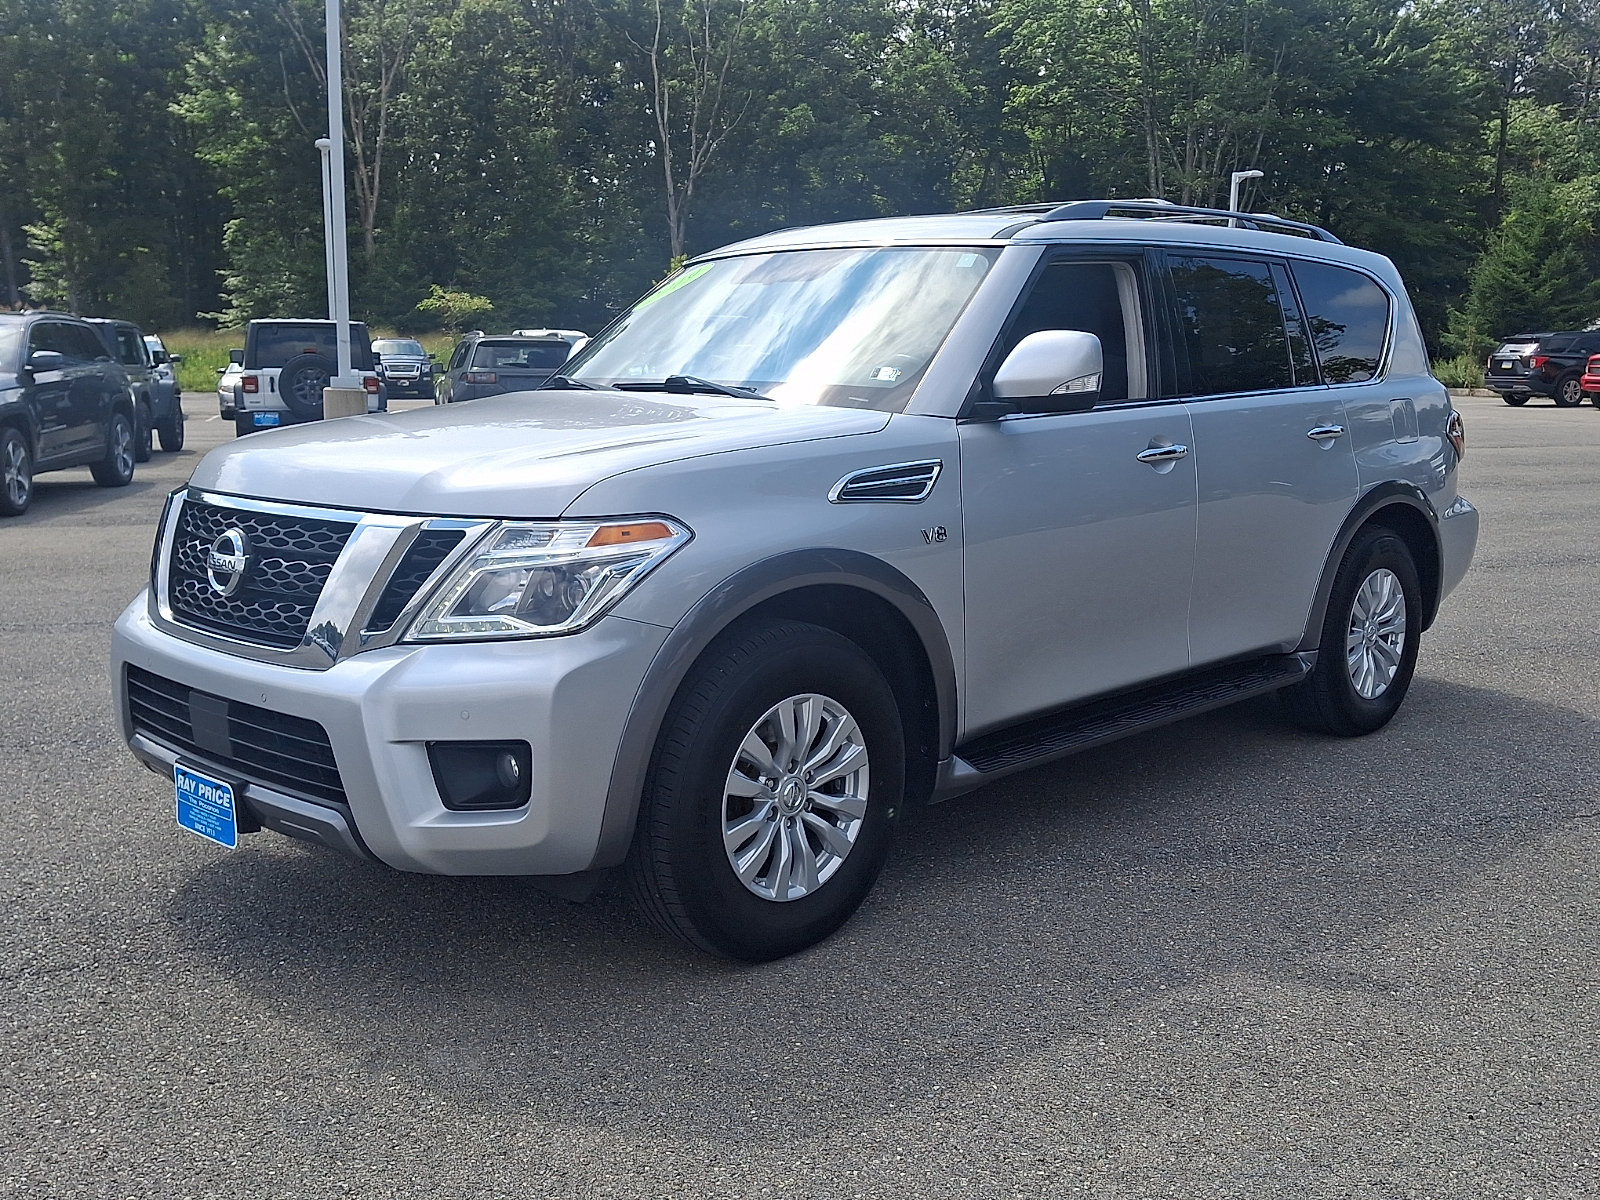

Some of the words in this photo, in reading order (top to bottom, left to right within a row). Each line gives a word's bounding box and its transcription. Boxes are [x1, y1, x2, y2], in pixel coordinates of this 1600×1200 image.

[920, 526, 947, 544] V8
[178, 774, 196, 793] RAY
[198, 784, 230, 807] PRICE
